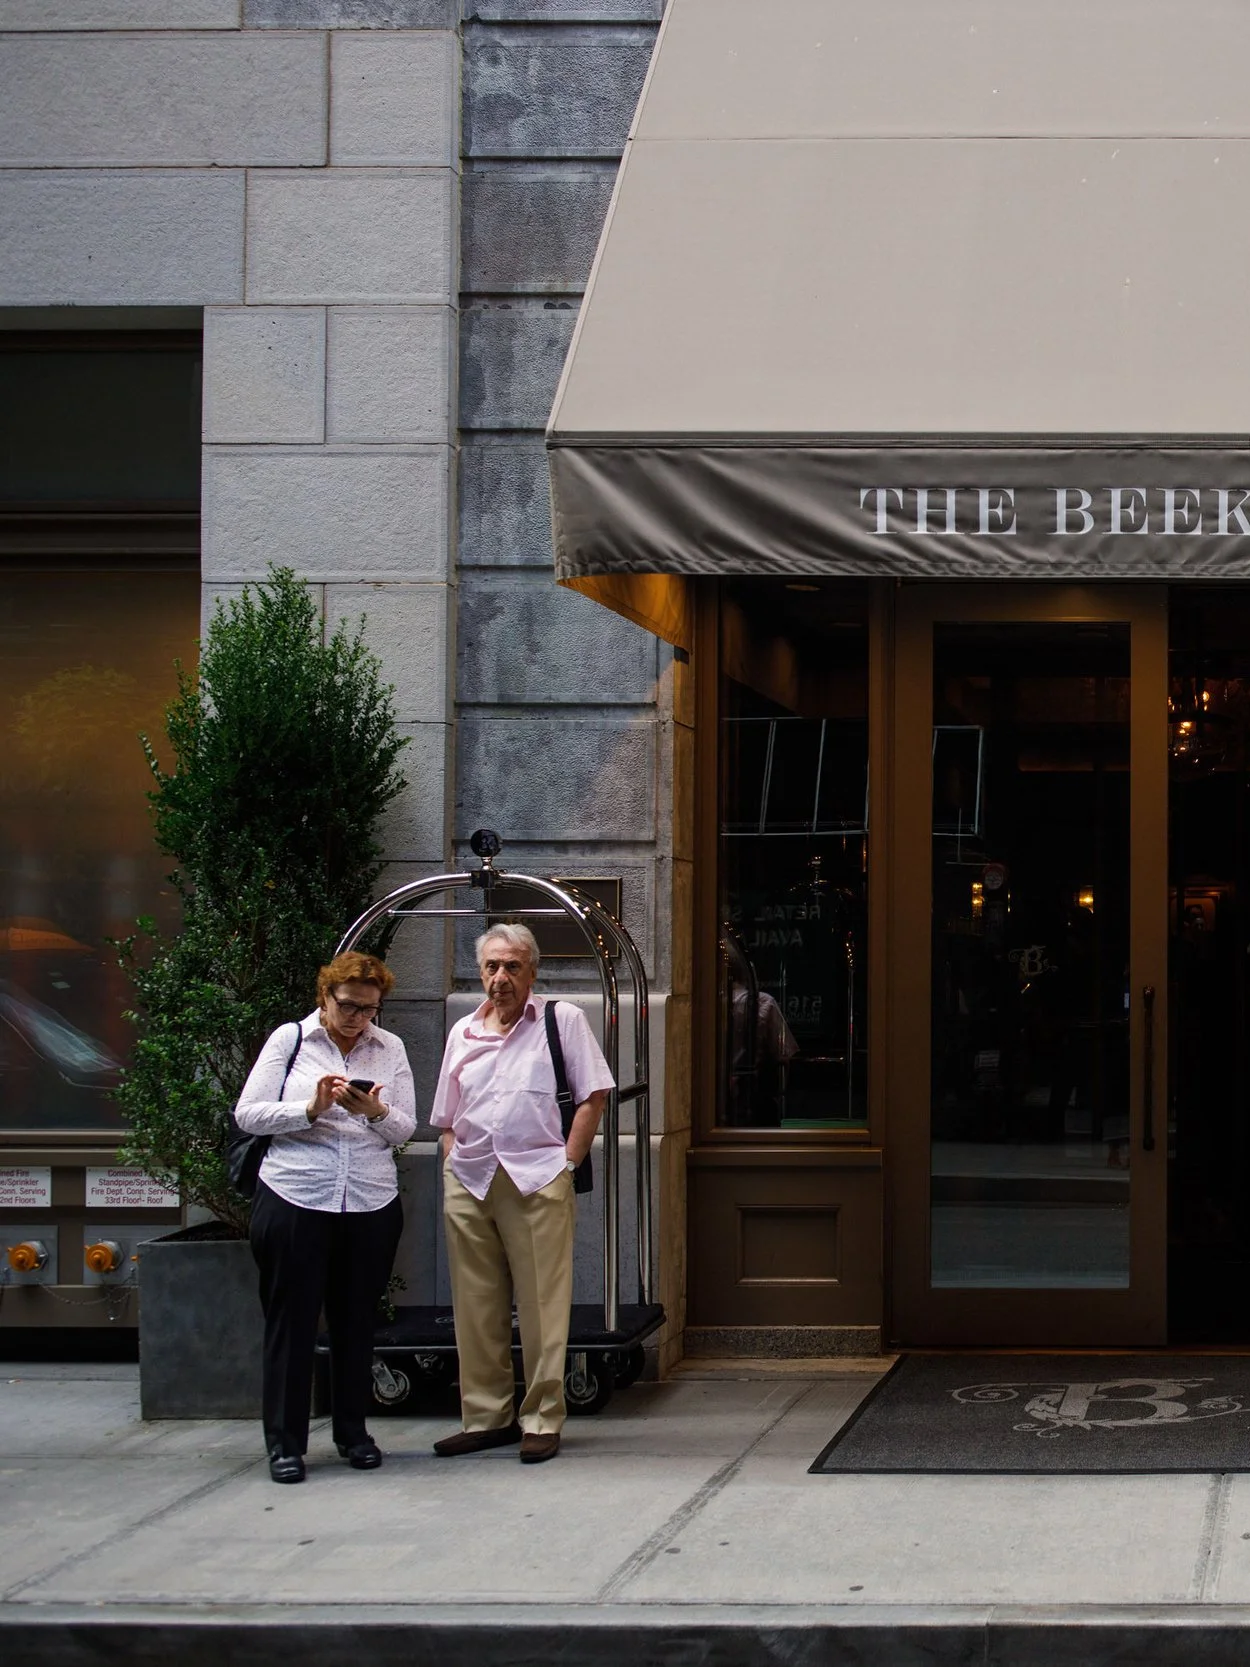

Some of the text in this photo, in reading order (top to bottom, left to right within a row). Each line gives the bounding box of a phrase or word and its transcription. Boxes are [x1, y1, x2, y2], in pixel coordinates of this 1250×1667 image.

[860, 487, 1017, 536] THE
[107, 1169, 143, 1177] Combined
[20, 1187, 46, 1196] Serving
[91, 1187, 105, 1195] Fire
[15, 1196, 36, 1204] Floors
[104, 1196, 121, 1205] 33rd
[122, 1196, 141, 1204] Floor
[146, 1196, 163, 1204] Roof
